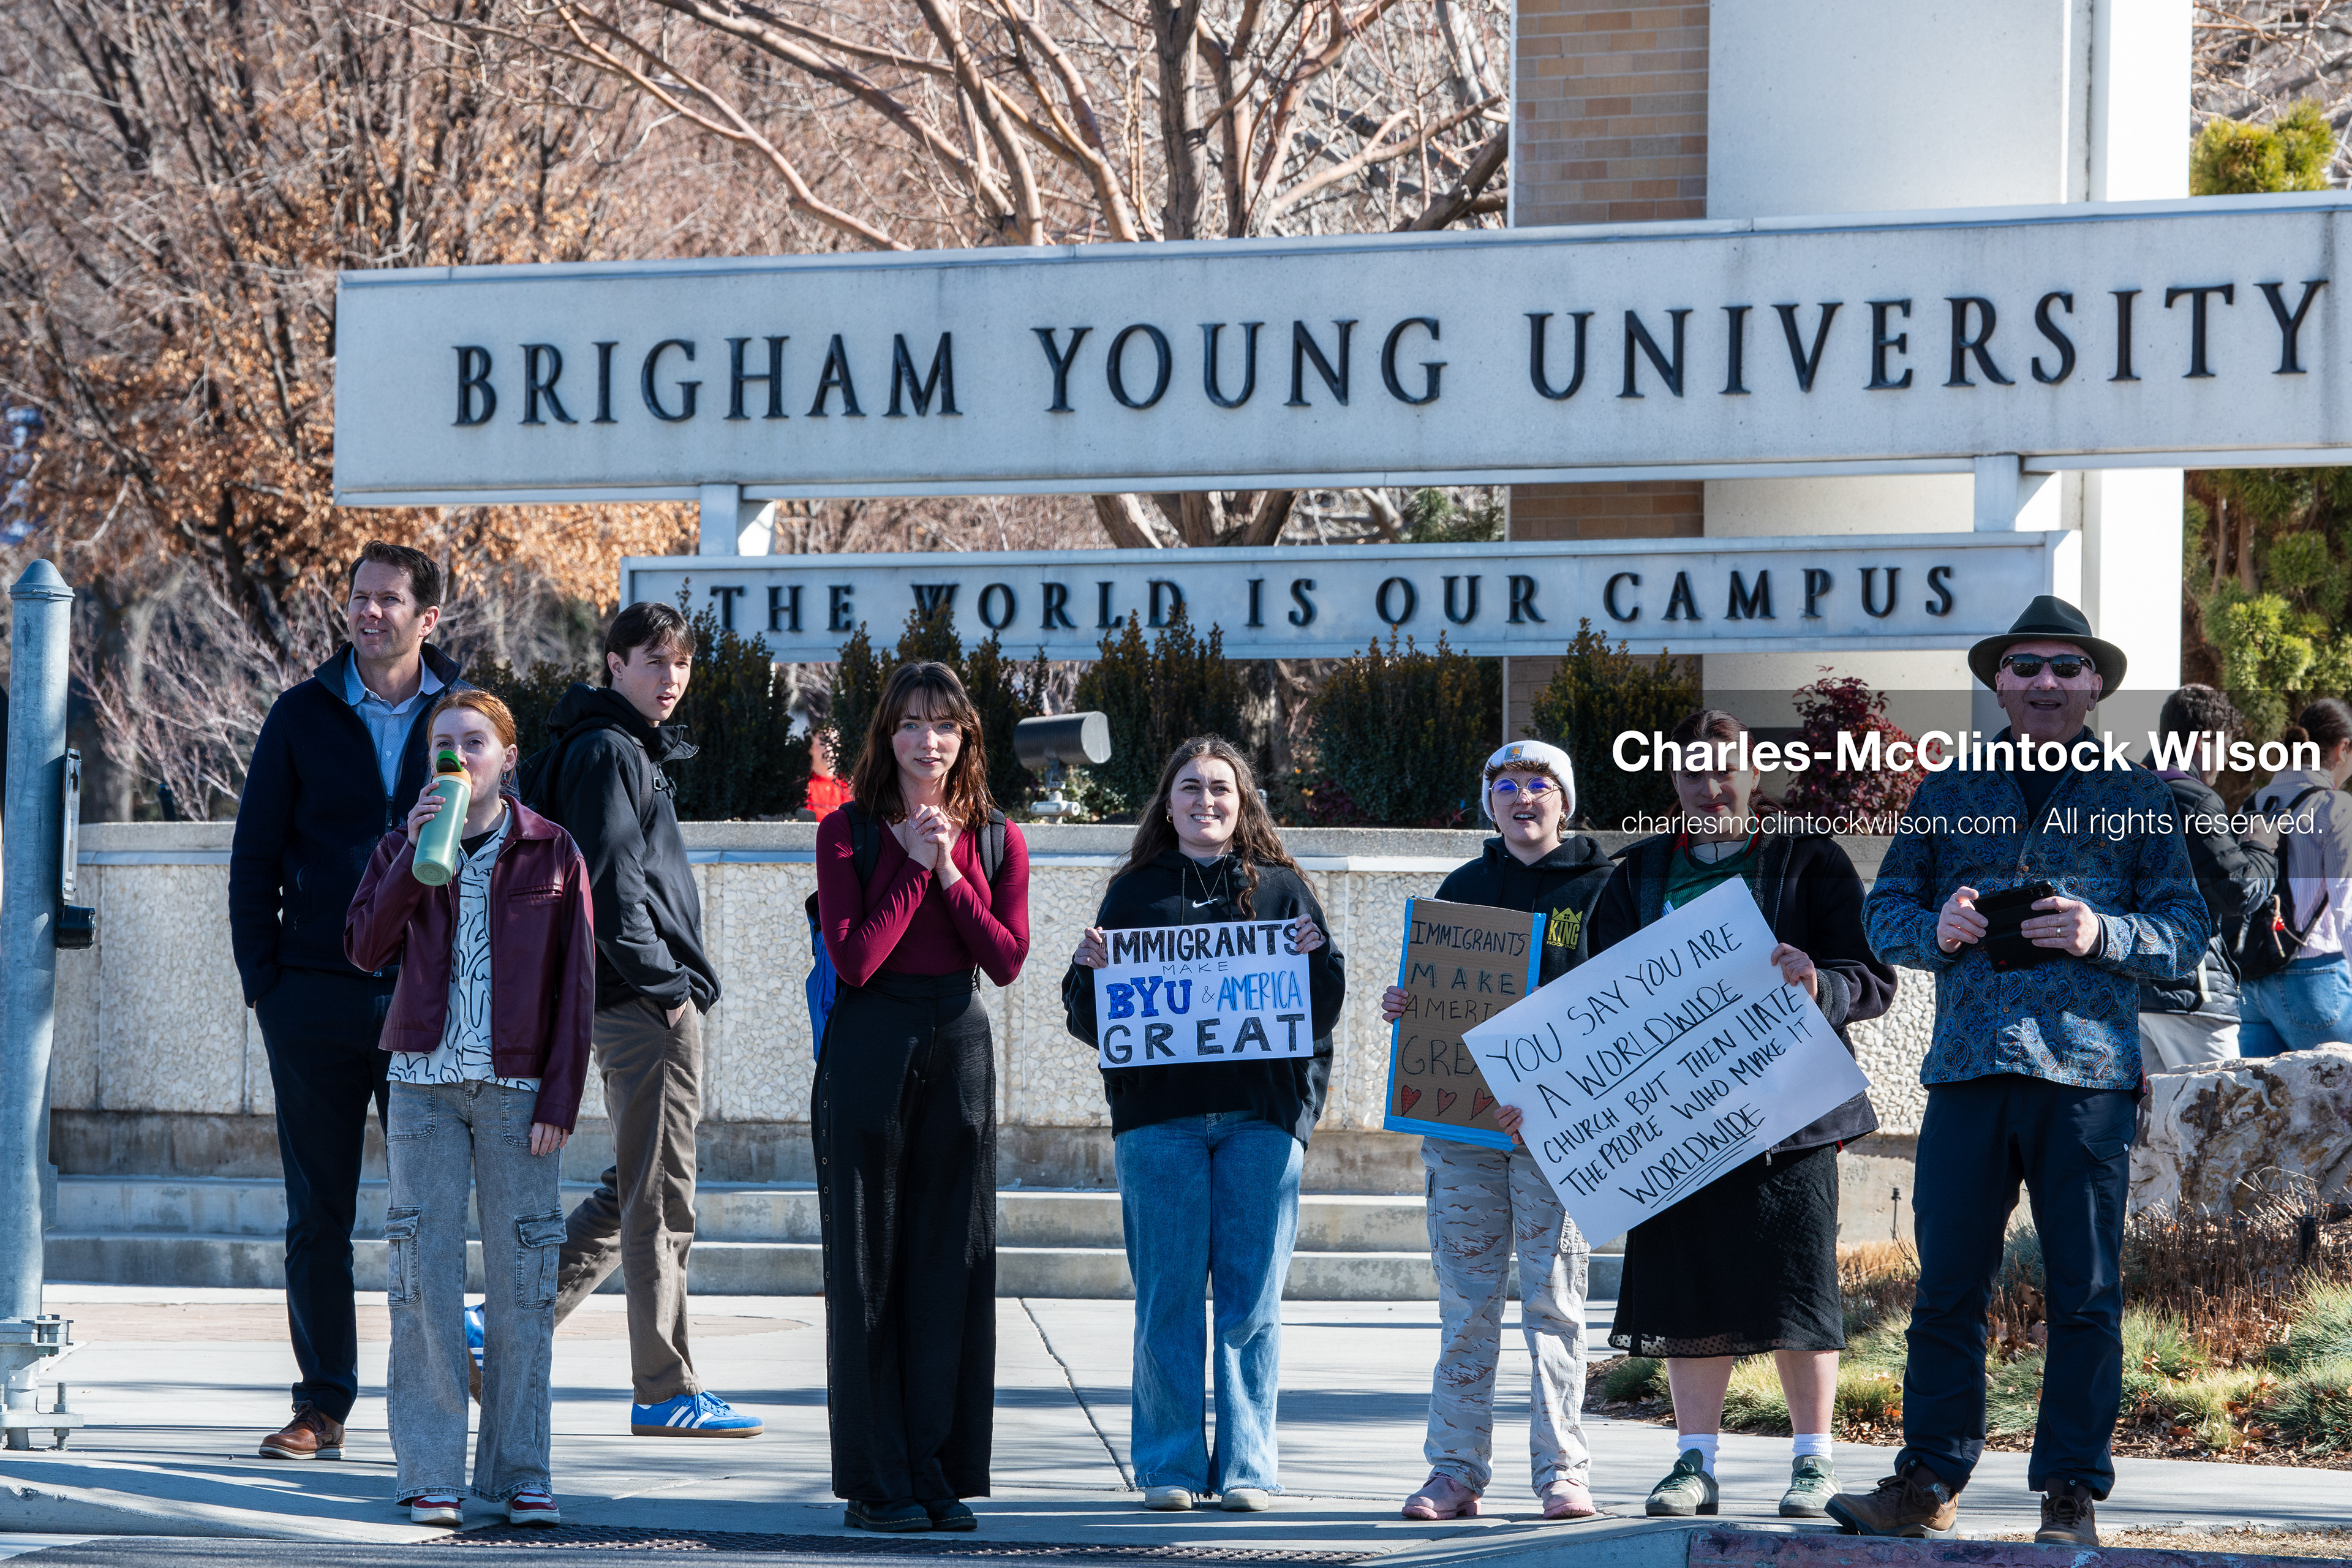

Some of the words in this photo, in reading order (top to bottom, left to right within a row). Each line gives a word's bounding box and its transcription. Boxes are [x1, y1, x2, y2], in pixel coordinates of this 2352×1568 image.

[450, 331, 963, 426] BRIGHAM
[1030, 316, 1448, 414] YOUNG
[1524, 279, 2329, 401] UNIVERSITY
[710, 583, 856, 632] THE
[910, 578, 1185, 632] WORLD
[1245, 578, 1317, 628] IS
[1375, 574, 1547, 625] OUR
[1602, 565, 1955, 624] CAMPUS
[1101, 922, 1302, 965] IMMIGRANTS
[1410, 920, 1531, 957] IMMIGRANTS
[1547, 940, 1576, 949] ROOFING
[1548, 919, 1580, 946] KING
[1163, 960, 1230, 976] MAKE
[1410, 961, 1517, 997] MAKE
[1106, 975, 1193, 1020] BYU
[1201, 985, 1216, 1004] &
[1216, 970, 1304, 1012] AMERICA
[1406, 993, 1506, 1023] AMERI
[1485, 1022, 1564, 1083] YOU
[1566, 979, 1630, 1036] SAY
[1625, 948, 1683, 995] YOU
[1686, 922, 1742, 969] ARE
[1102, 1013, 1306, 1065] GREAT
[1536, 1083, 1572, 1119] A
[1565, 978, 1743, 1099] WORLDWIDE
[1543, 1107, 1620, 1164] CHURCH
[1625, 1071, 1670, 1115] BUT
[1676, 1027, 1738, 1078] THEN
[1735, 982, 1805, 1041] HATE
[1559, 1158, 1608, 1196] THE
[1598, 1115, 1664, 1170] PEOPLE
[1670, 1079, 1730, 1121] WHO
[1728, 1044, 1787, 1087] MAKE
[1785, 1016, 1814, 1038] IT
[1618, 1102, 1766, 1205] WORLDWIDE
